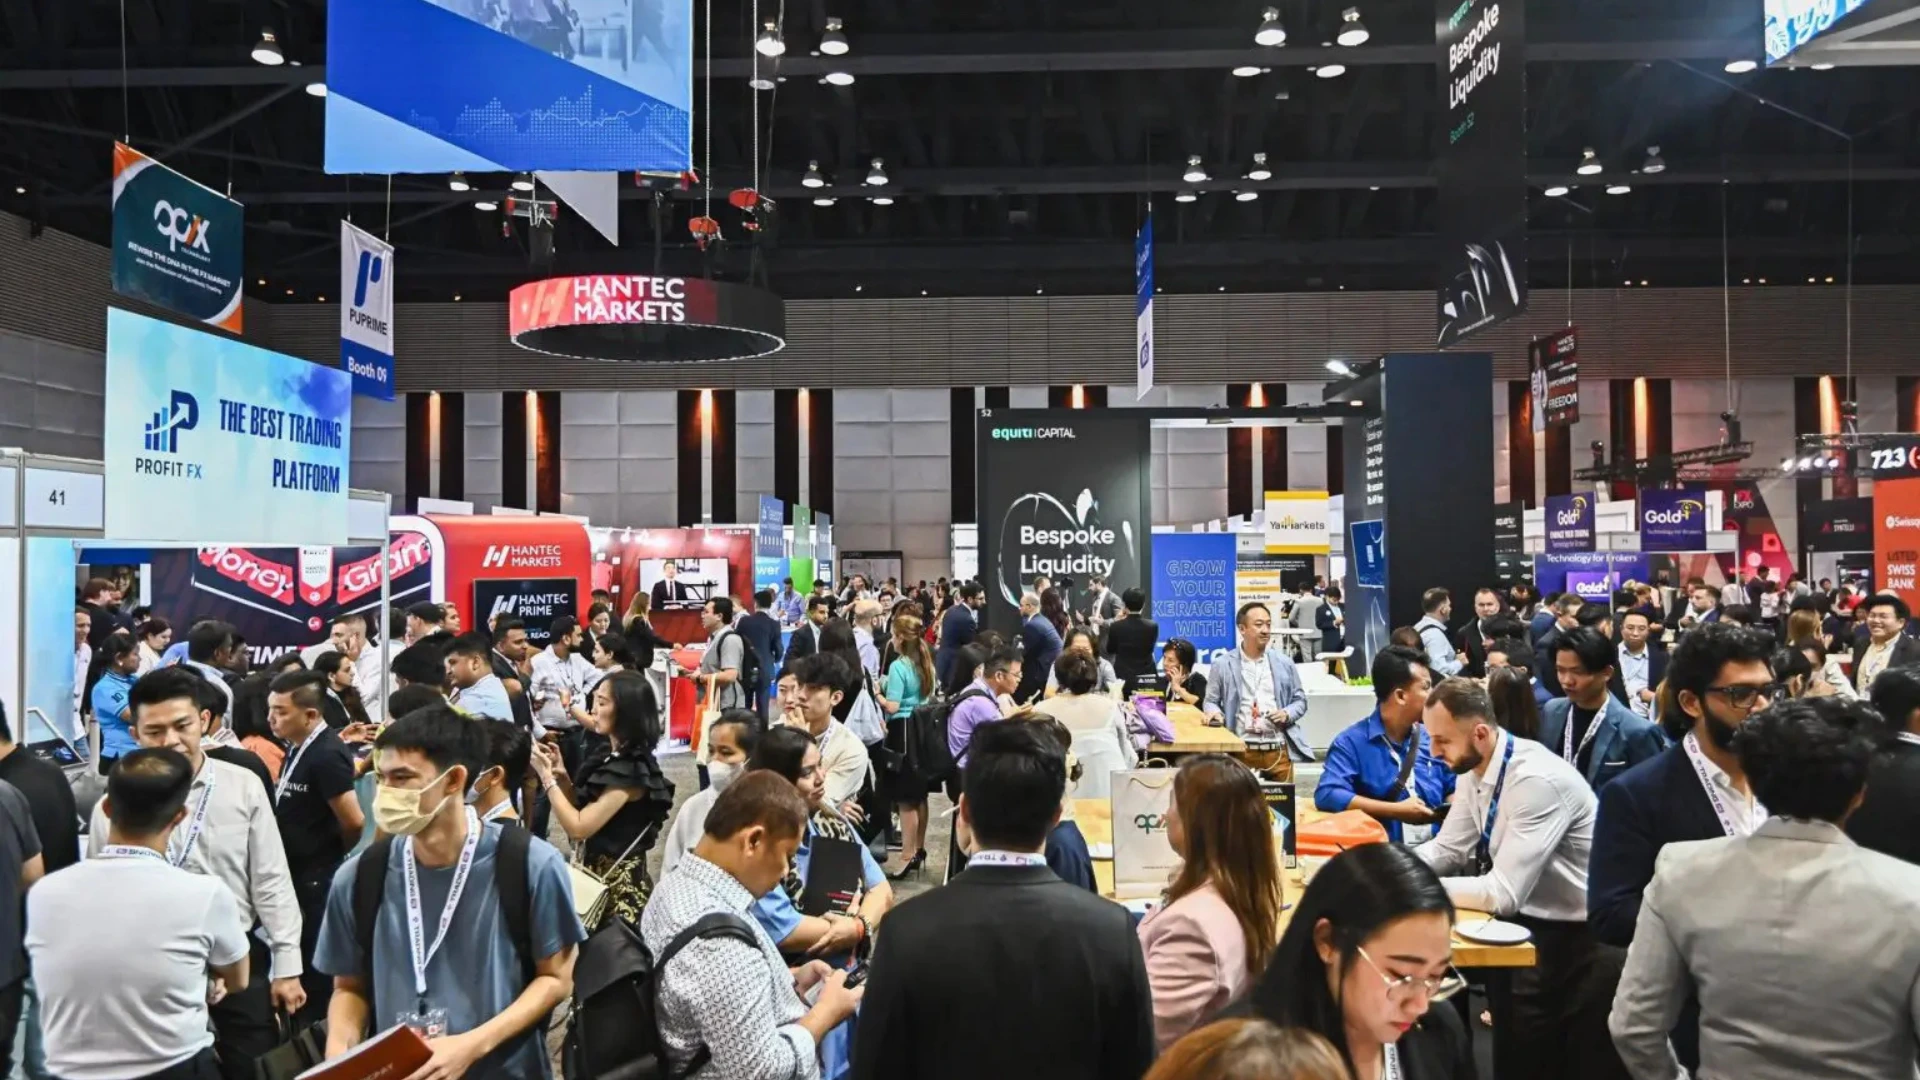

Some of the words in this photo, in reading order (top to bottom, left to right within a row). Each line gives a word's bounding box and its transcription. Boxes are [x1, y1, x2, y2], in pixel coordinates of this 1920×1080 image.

[1450, 4, 1499, 73] Bespoke
[1450, 42, 1500, 110] Liquidity
[154, 251, 166, 263] THE
[167, 255, 180, 268] DNA
[188, 262, 199, 276] THE
[207, 271, 231, 288] MARKET
[573, 277, 685, 300] HANTEC
[573, 300, 685, 322] MARKETS
[348, 356, 376, 379] Booth
[377, 365, 387, 383] 09
[1548, 392, 1577, 409] FREEDOM
[219, 398, 246, 434] THE
[249, 405, 285, 440] BEST
[288, 413, 341, 449] TRADING
[992, 427, 1032, 441] equiti
[1037, 427, 1076, 438] CAPITAL
[135, 457, 184, 478] PROFIT
[186, 463, 203, 480] FX
[272, 458, 341, 494] PLATFORM
[48, 489, 65, 506] 41
[1020, 525, 1115, 549] Bespoke
[511, 545, 561, 555] HANTEC
[1546, 553, 1591, 564] Technology
[1592, 553, 1604, 562] for
[511, 557, 562, 567] MARKETS
[1020, 554, 1115, 579] Liquidity
[1166, 560, 1227, 577] GROW
[1887, 563, 1915, 575] SWISS
[198, 547, 294, 598] Money
[1171, 580, 1227, 597] YOUR
[1887, 577, 1915, 589] BANK
[519, 593, 569, 605] HANTEC
[519, 605, 552, 616] PRIME
[1175, 620, 1226, 638] WITH
